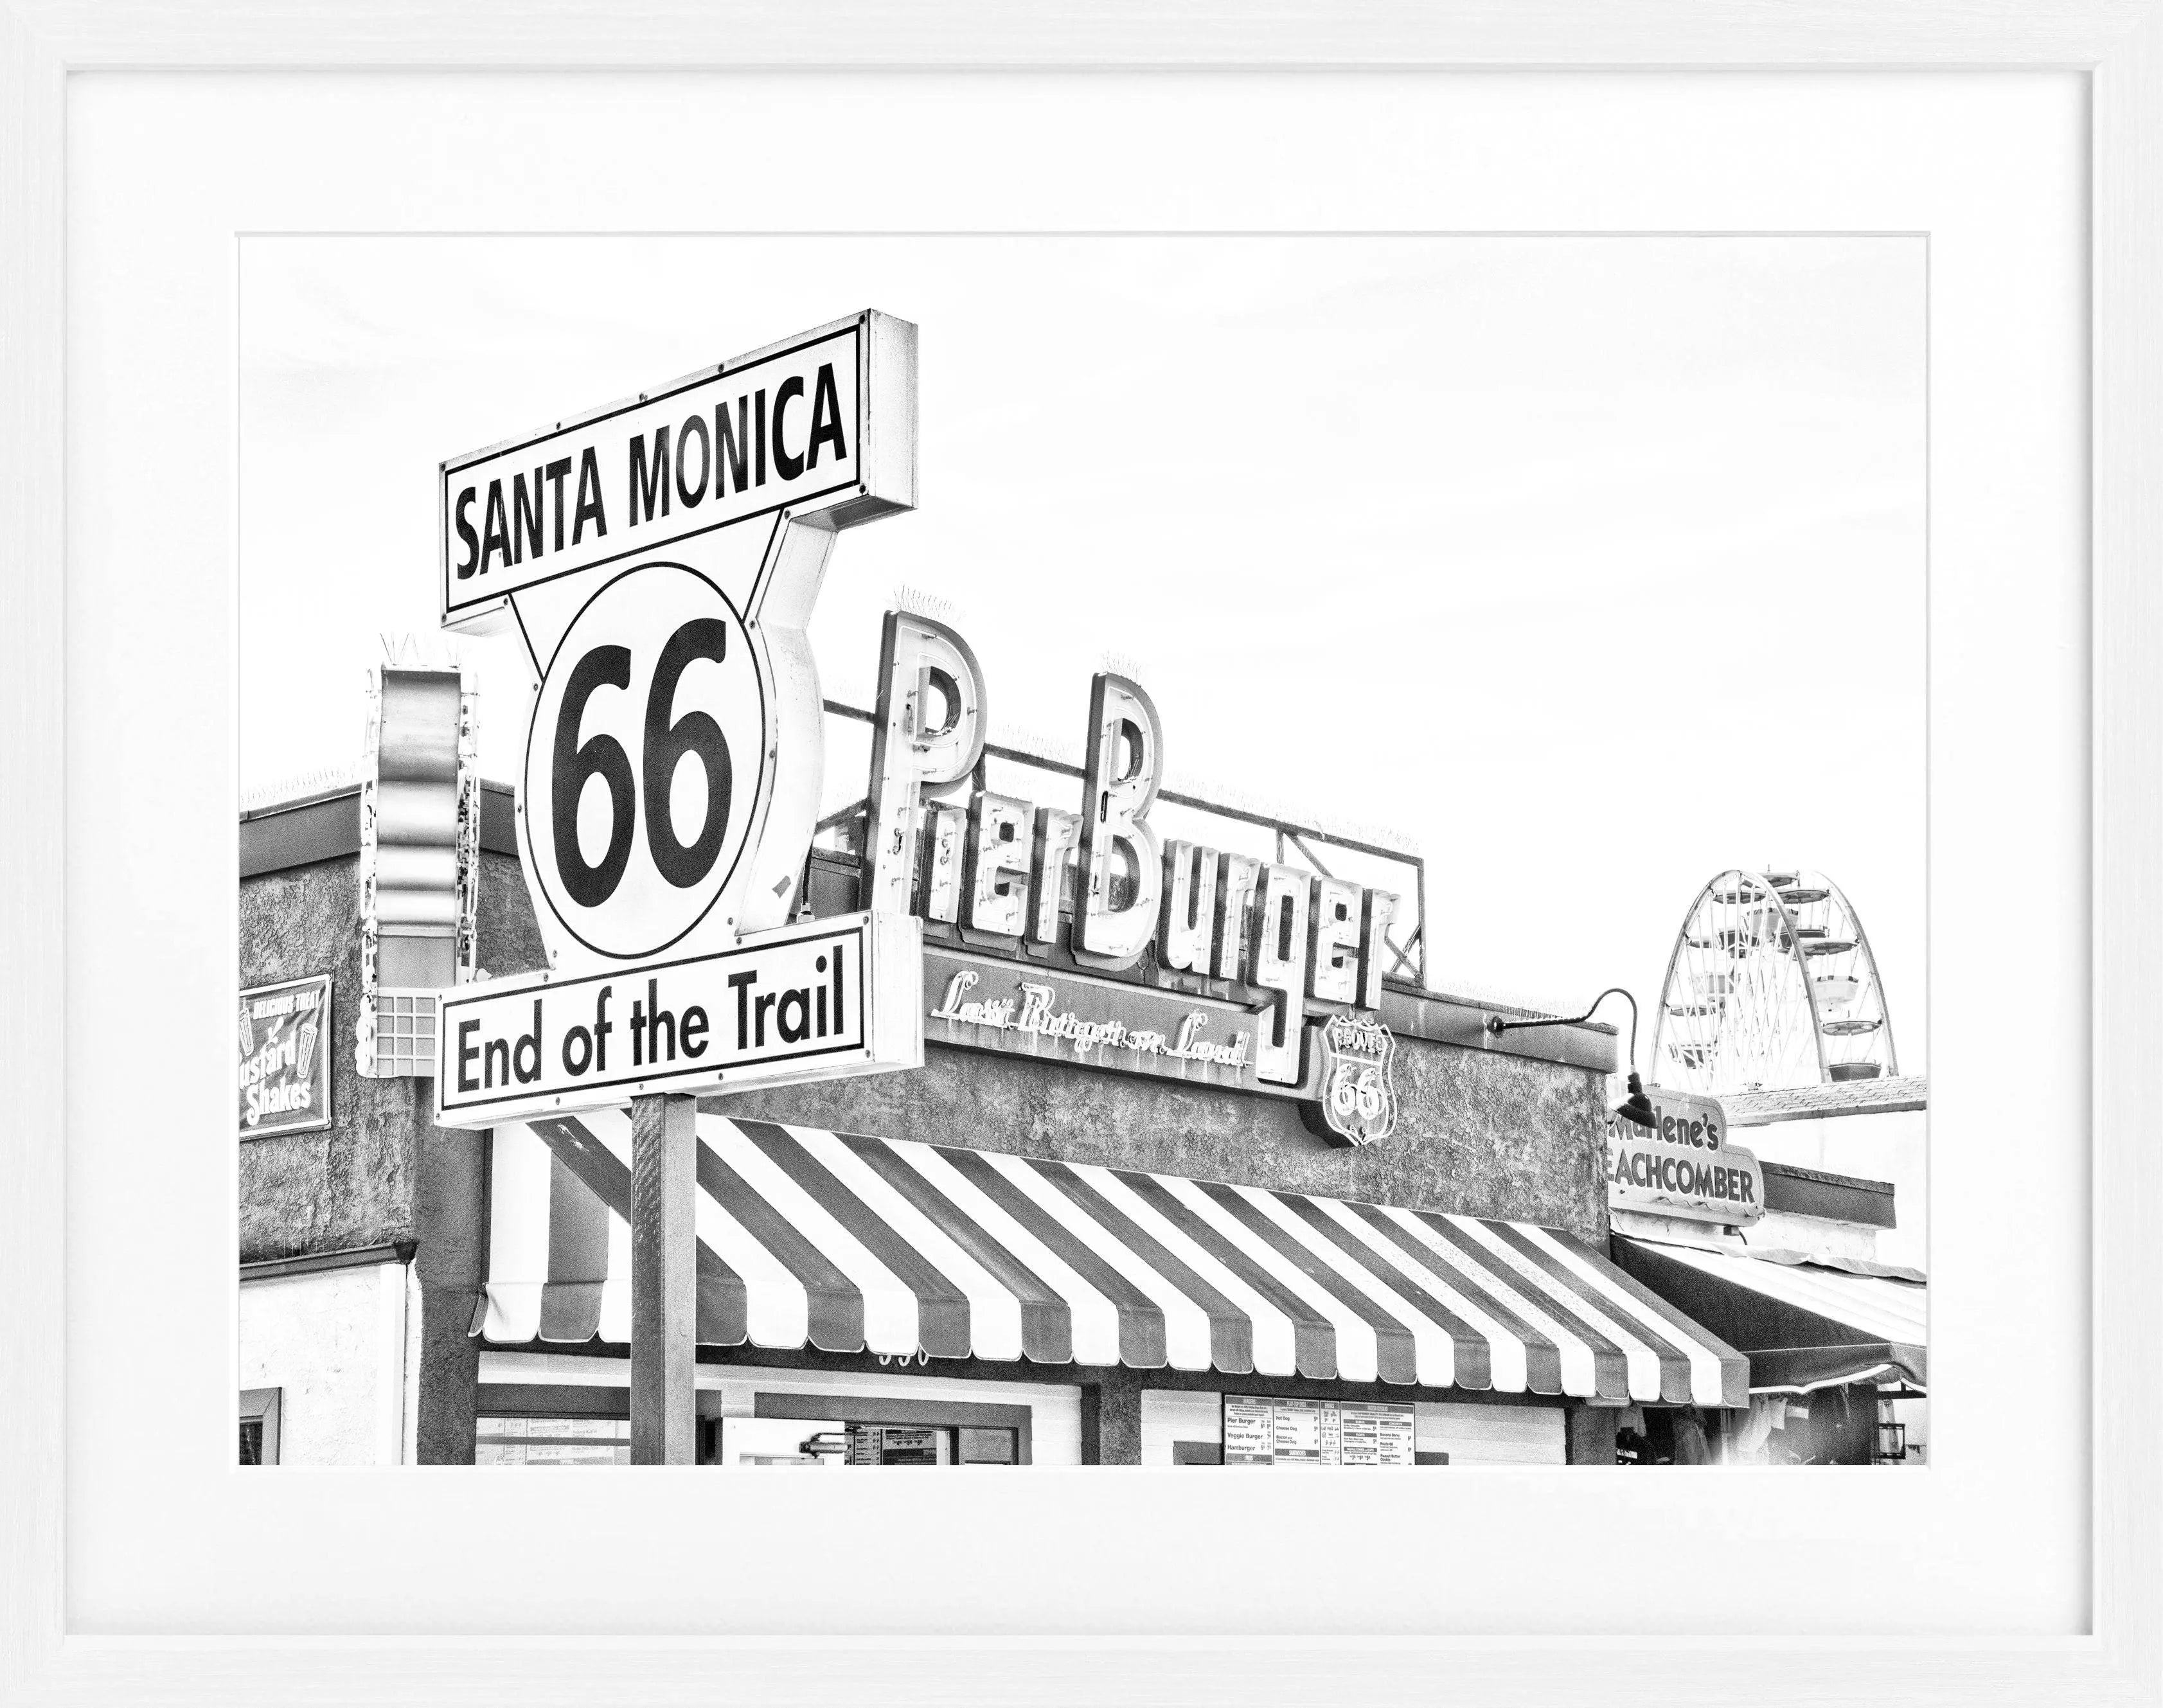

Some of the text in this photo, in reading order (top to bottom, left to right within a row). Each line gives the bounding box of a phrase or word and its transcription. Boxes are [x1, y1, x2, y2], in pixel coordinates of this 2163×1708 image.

[456, 362, 847, 580] SANTA MONICA
[552, 618, 733, 908] 66
[1072, 672, 1401, 1085] Burger
[253, 990, 320, 1020] DELICIOUS TREAT
[458, 945, 844, 1093] End of the Trail
[239, 1027, 296, 1090] ustard
[246, 1076, 311, 1126] Shakes
[1333, 1063, 1385, 1120] 66
